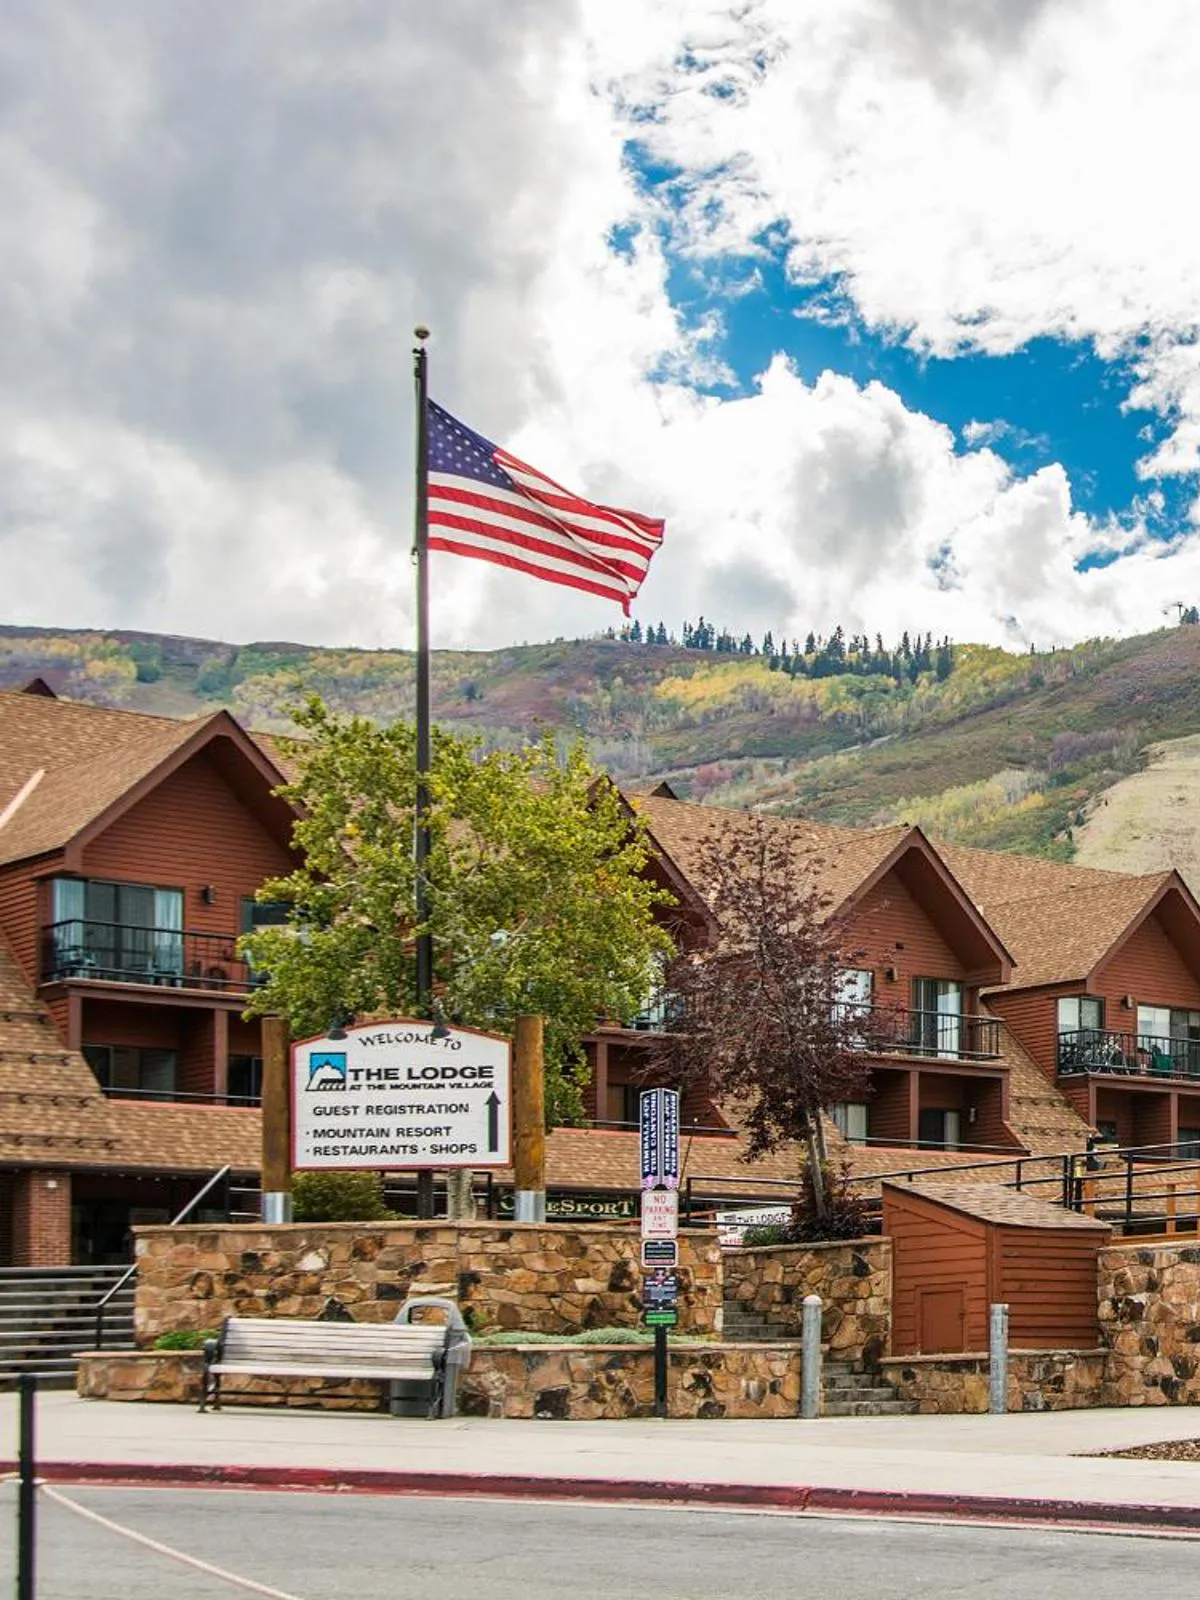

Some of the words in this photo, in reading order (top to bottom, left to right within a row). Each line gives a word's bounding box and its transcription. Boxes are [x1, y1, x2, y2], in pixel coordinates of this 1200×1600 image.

[358, 1032, 437, 1048] WELCOME
[442, 1038, 462, 1050] TO
[349, 1068, 400, 1081] THE
[407, 1065, 495, 1080] LODGE
[390, 1082, 445, 1090] MOUNTAIN
[450, 1081, 494, 1089] VILLAGE
[313, 1105, 360, 1116] GUEST
[365, 1103, 470, 1115] REGISTRATION
[313, 1127, 390, 1139] MOUNTAIN
[396, 1126, 453, 1137] RESORT
[313, 1144, 418, 1156] RESTAURANTS
[430, 1143, 478, 1154] SHOPS
[654, 1194, 666, 1204] NO
[645, 1206, 676, 1214] PARKING
